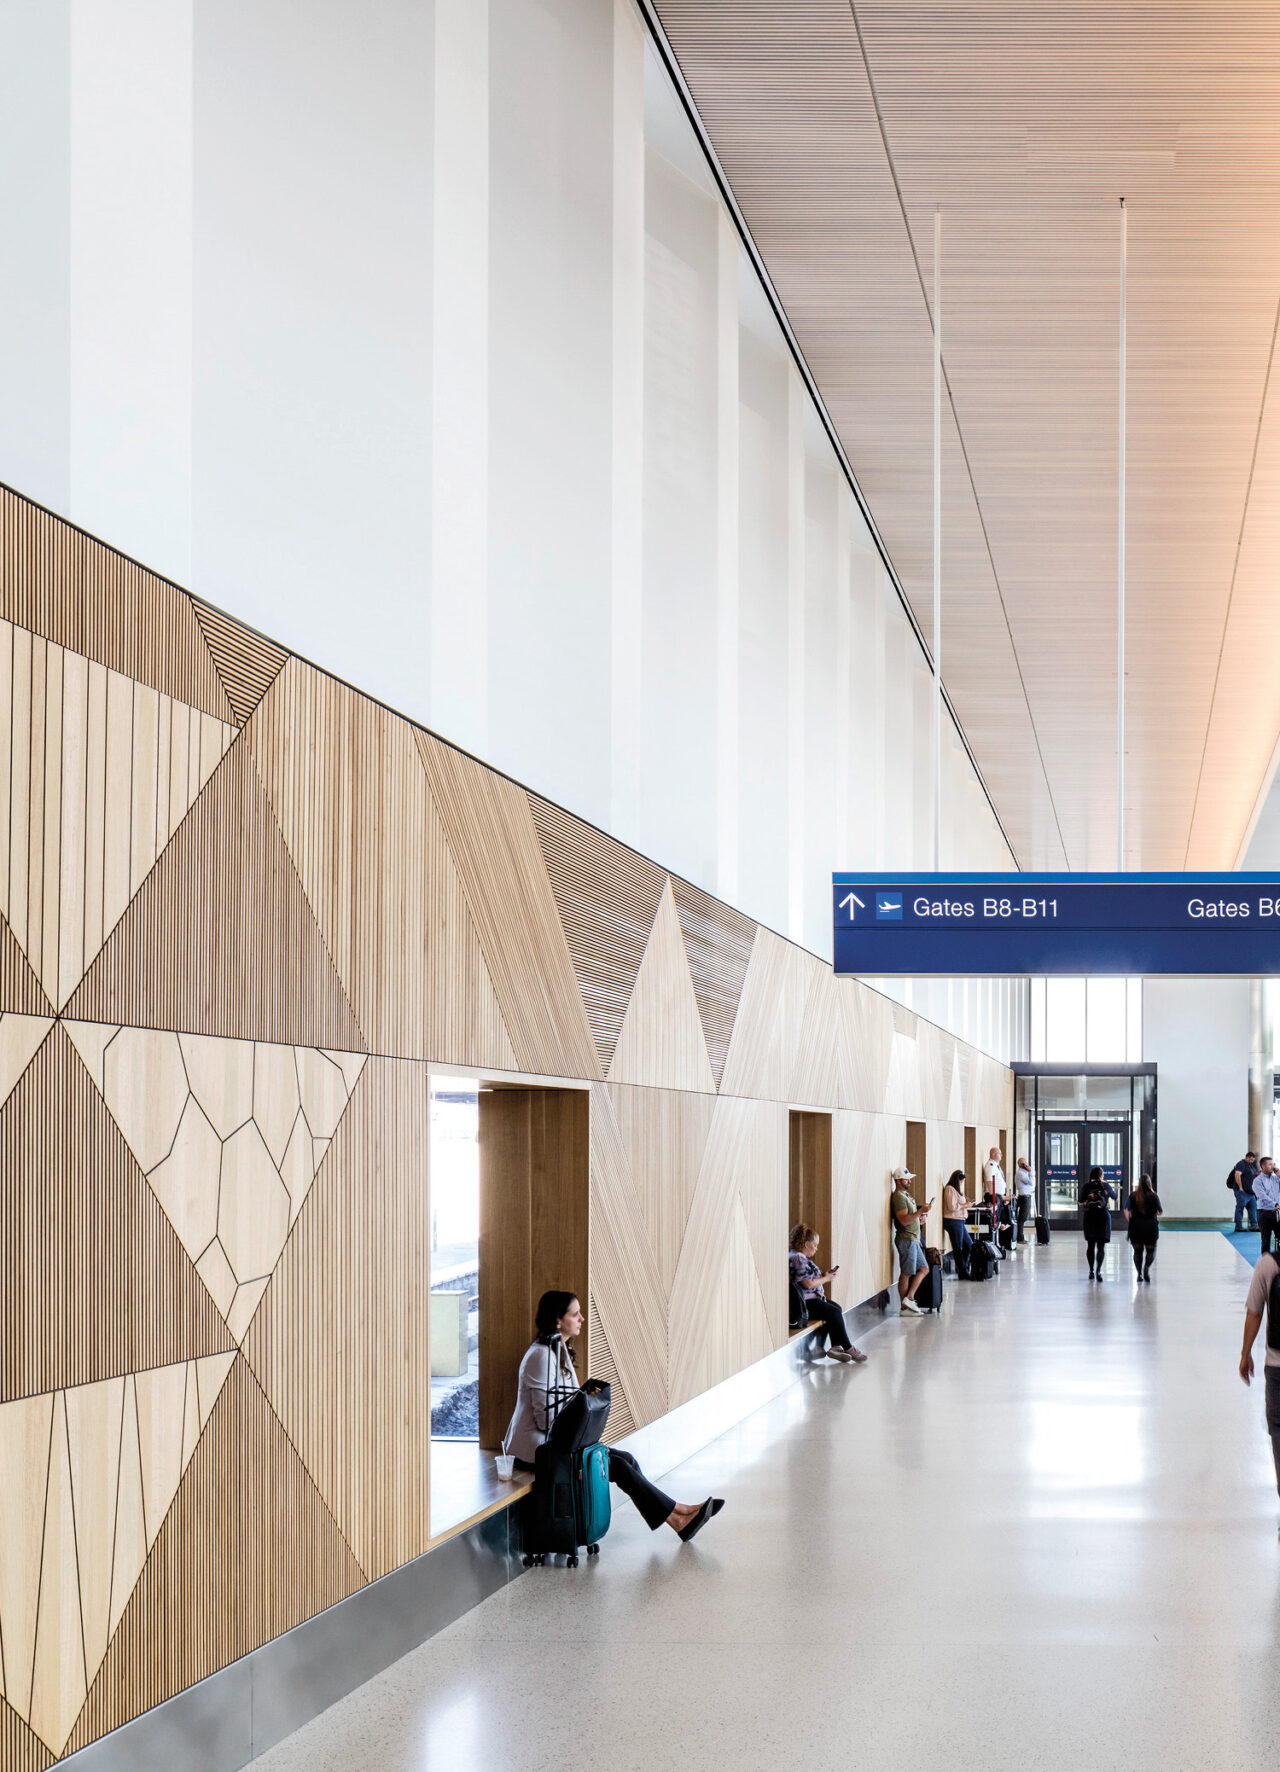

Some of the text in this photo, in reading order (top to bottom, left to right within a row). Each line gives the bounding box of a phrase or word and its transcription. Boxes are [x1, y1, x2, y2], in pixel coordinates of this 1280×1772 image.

[913, 897, 1058, 917] Gates B8-B11
[1187, 898, 1250, 918] Gates
